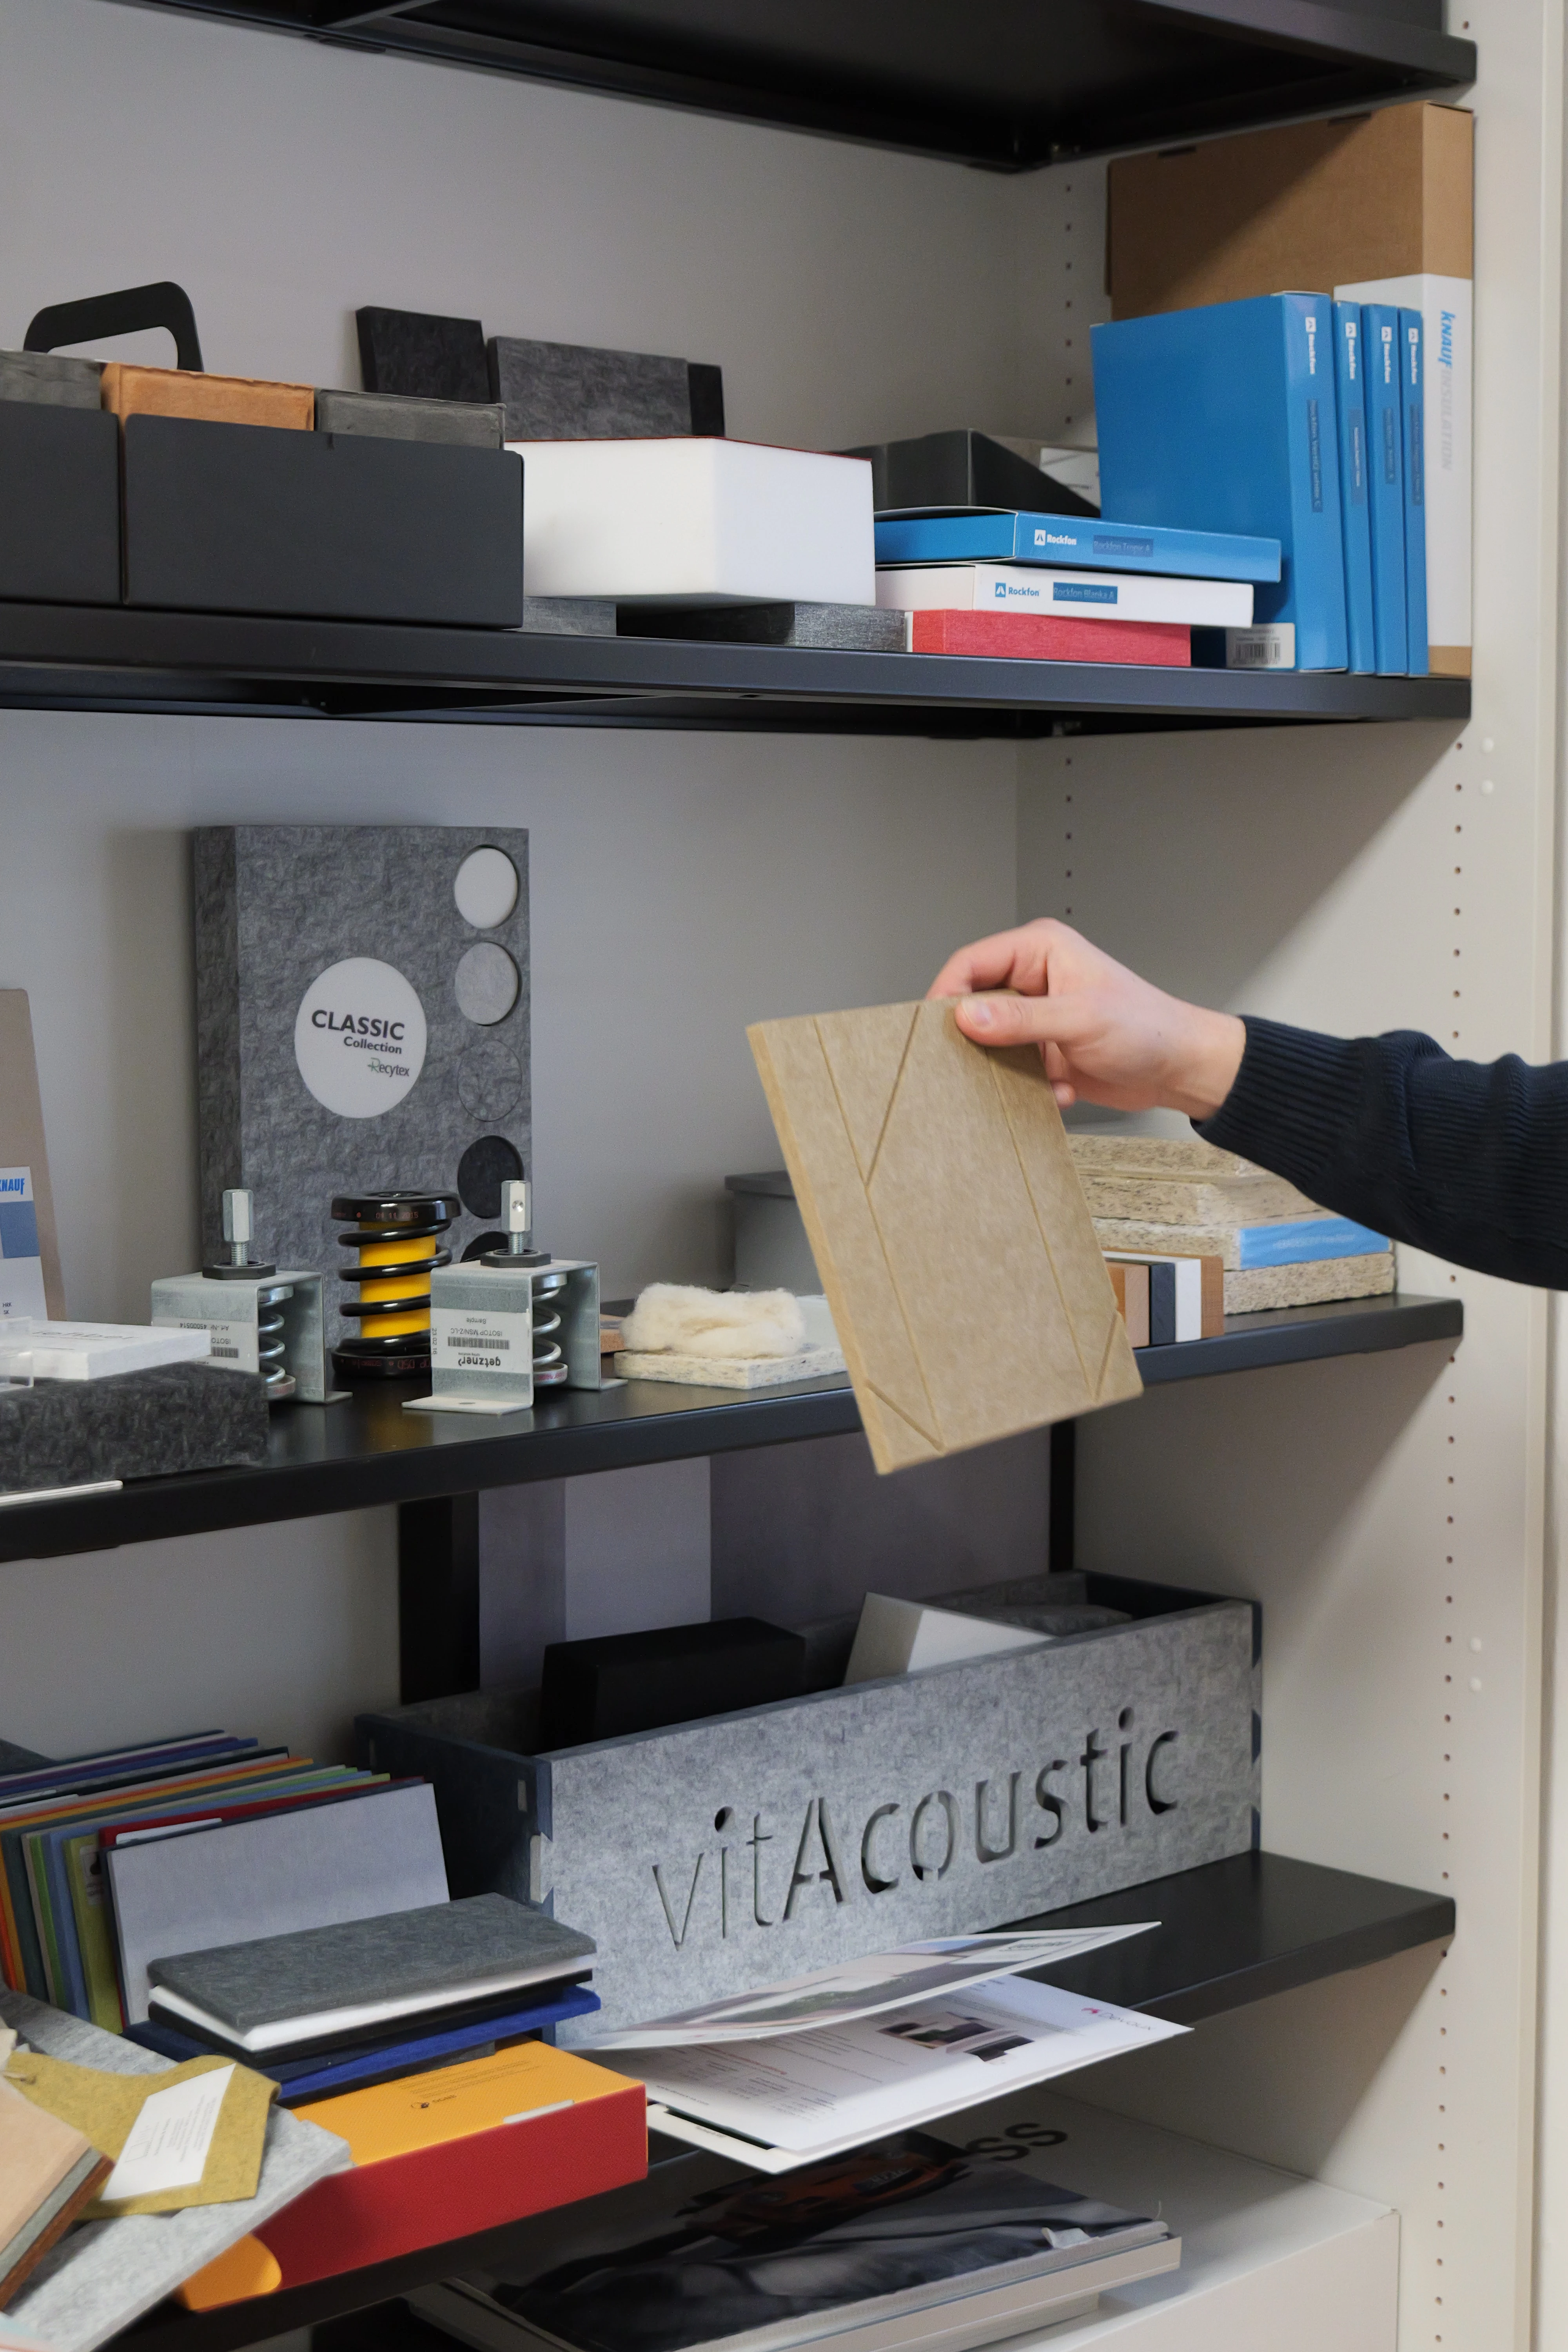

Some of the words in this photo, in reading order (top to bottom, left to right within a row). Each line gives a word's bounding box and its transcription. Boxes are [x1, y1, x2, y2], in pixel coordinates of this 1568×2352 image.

[1438, 310, 1455, 368] KNAUF
[1047, 534, 1077, 545] Rockfon
[1009, 587, 1039, 597] Rockfon
[312, 1009, 405, 1040] CLASSIC
[344, 1036, 402, 1054] Collection
[367, 1057, 410, 1077] Recytex
[461, 1356, 501, 1368] getzner
[652, 1706, 1178, 1952] vitAcoustic
